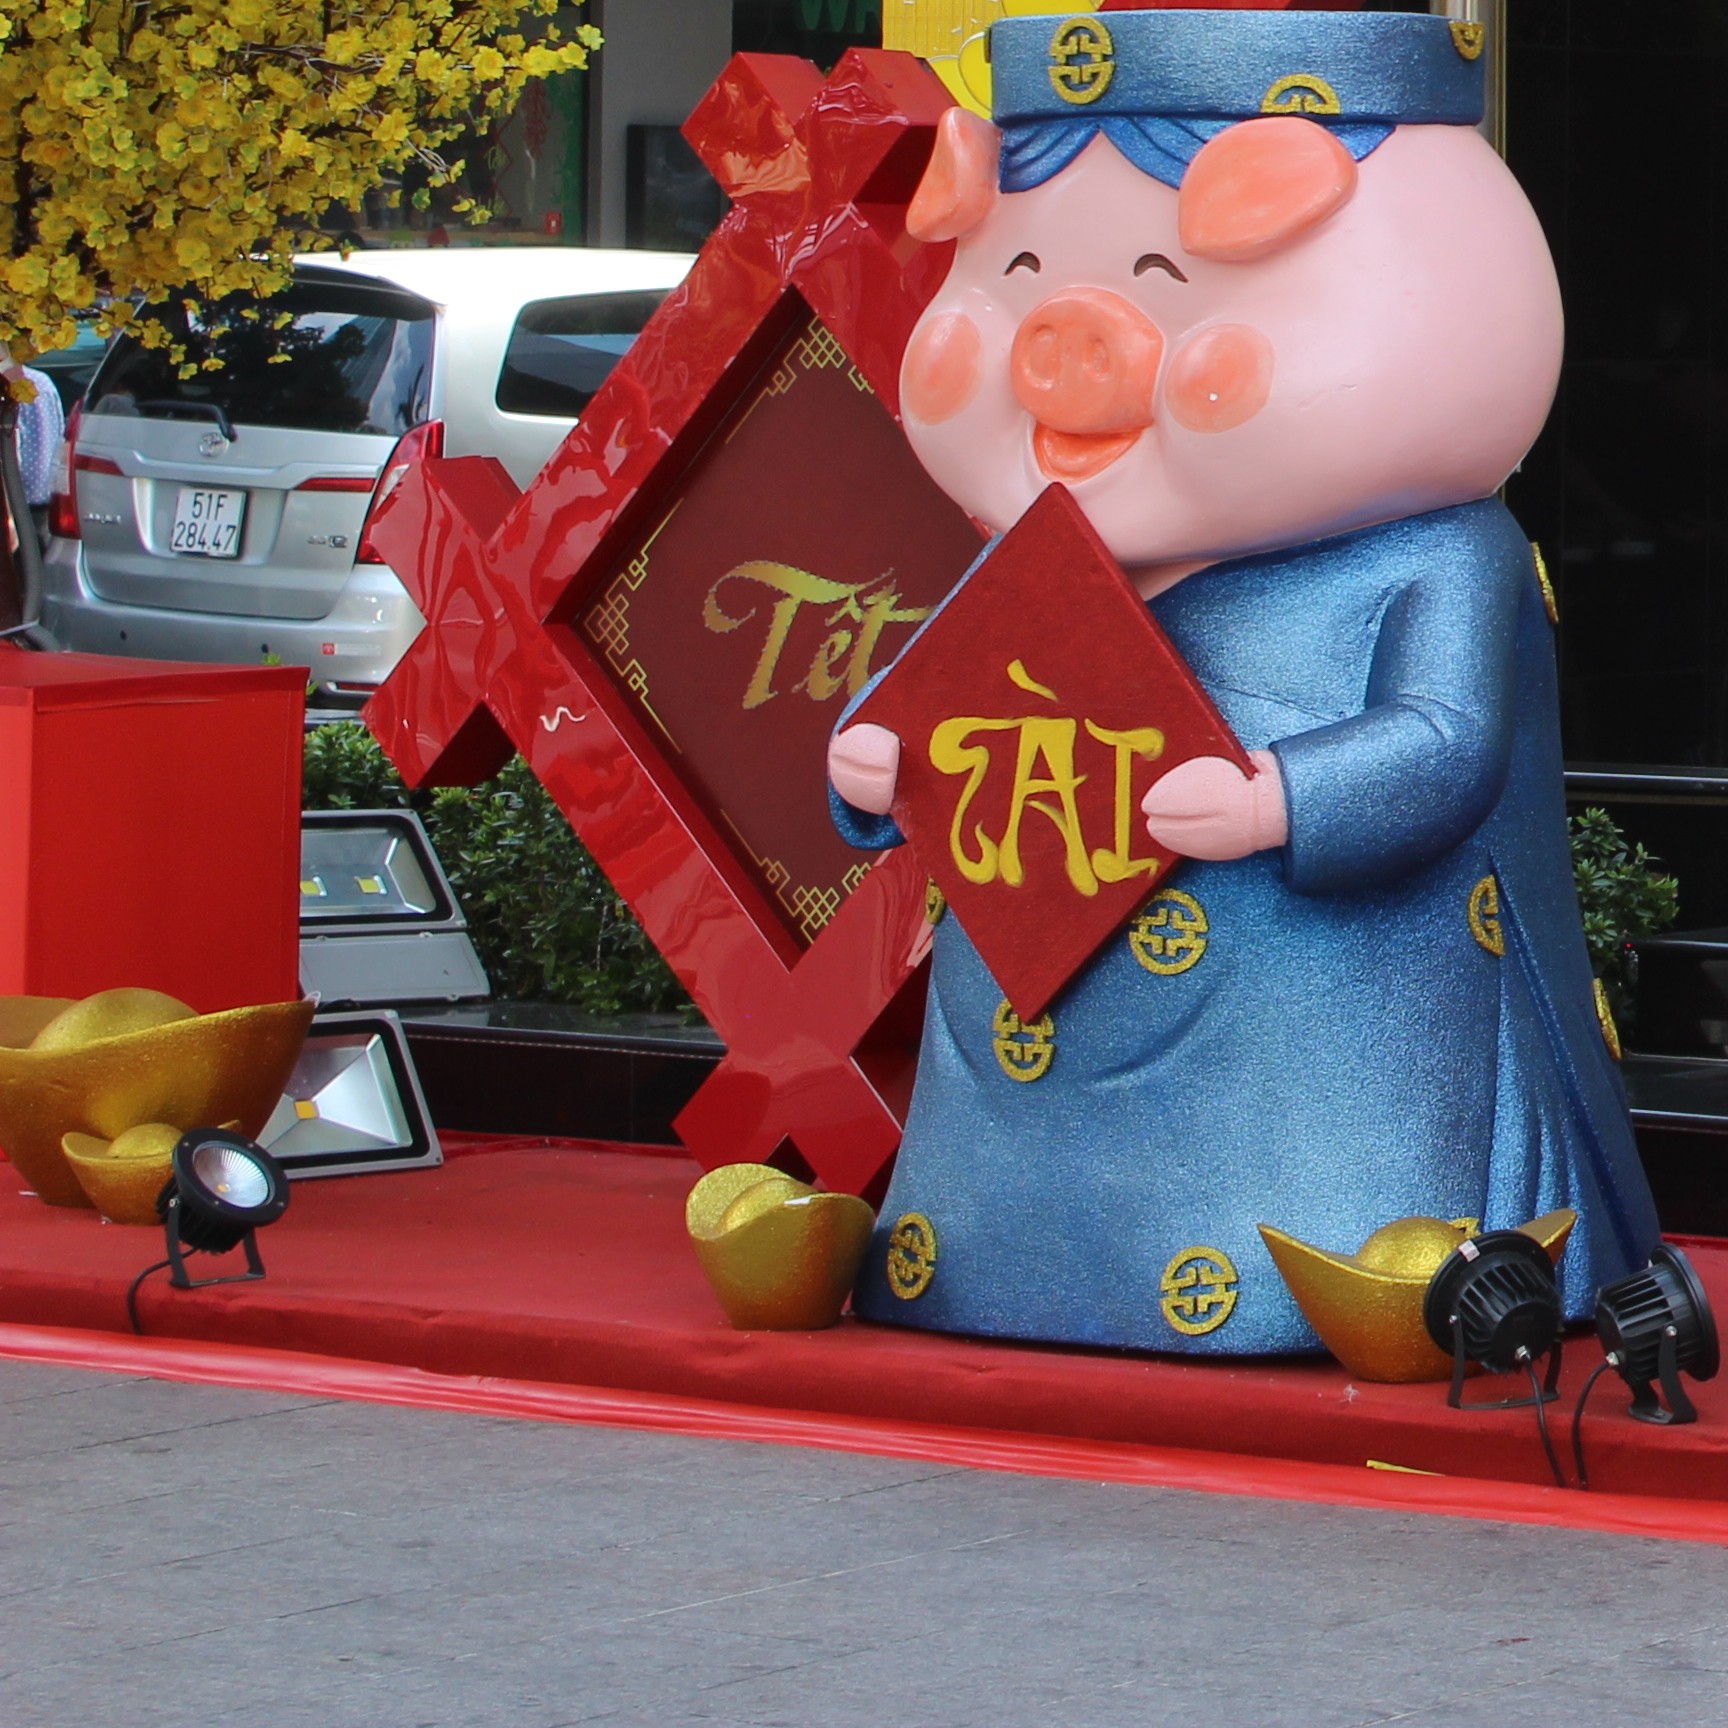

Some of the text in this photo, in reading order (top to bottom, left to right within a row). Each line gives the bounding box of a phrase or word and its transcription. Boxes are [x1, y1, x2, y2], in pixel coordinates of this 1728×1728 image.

[192, 492, 228, 521] 51F
[173, 521, 237, 551] 284.47
[703, 558, 938, 710] Tết
